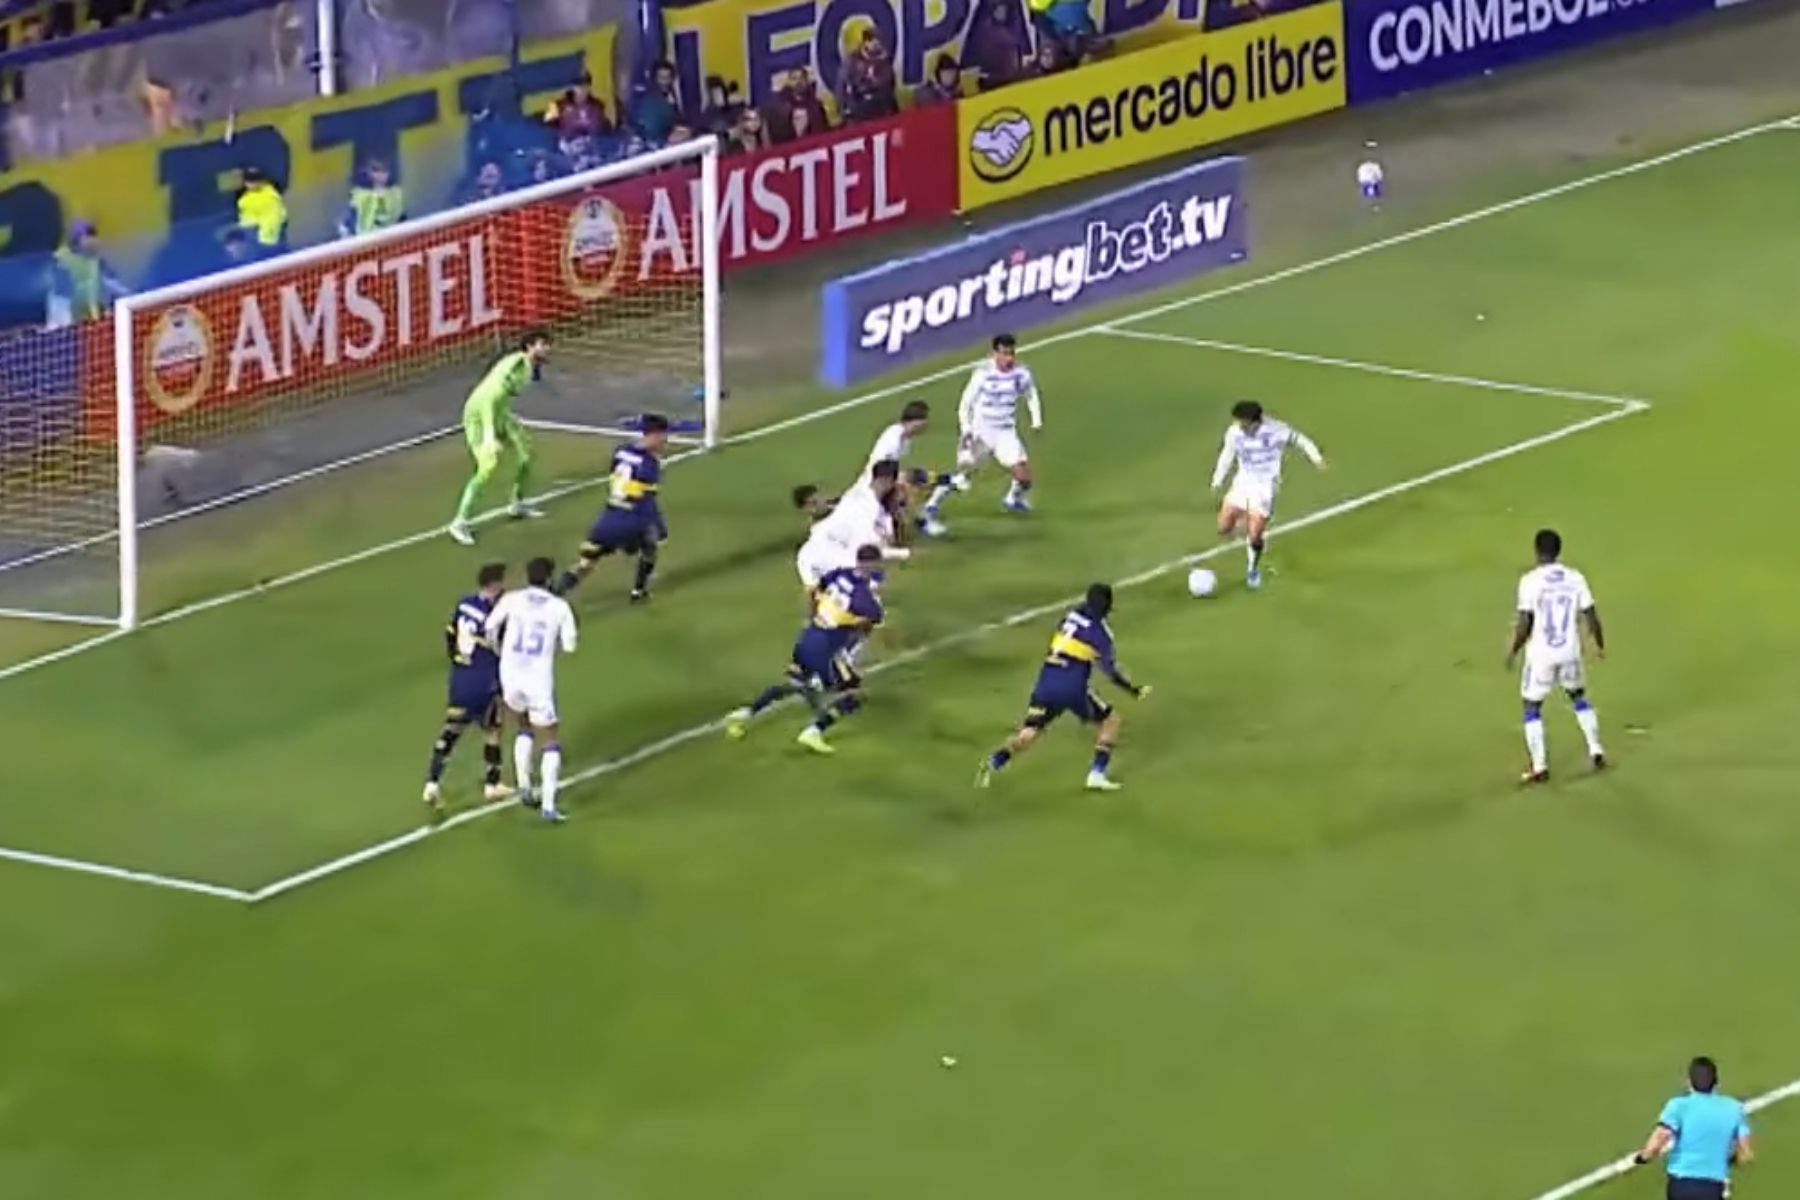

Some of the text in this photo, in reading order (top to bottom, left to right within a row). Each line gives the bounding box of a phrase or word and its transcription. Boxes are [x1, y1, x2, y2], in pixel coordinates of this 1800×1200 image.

[1044, 35, 1337, 156] mercado libre
[225, 233, 501, 392] AMSTEL
[860, 195, 1231, 352] sportingbet.tv
